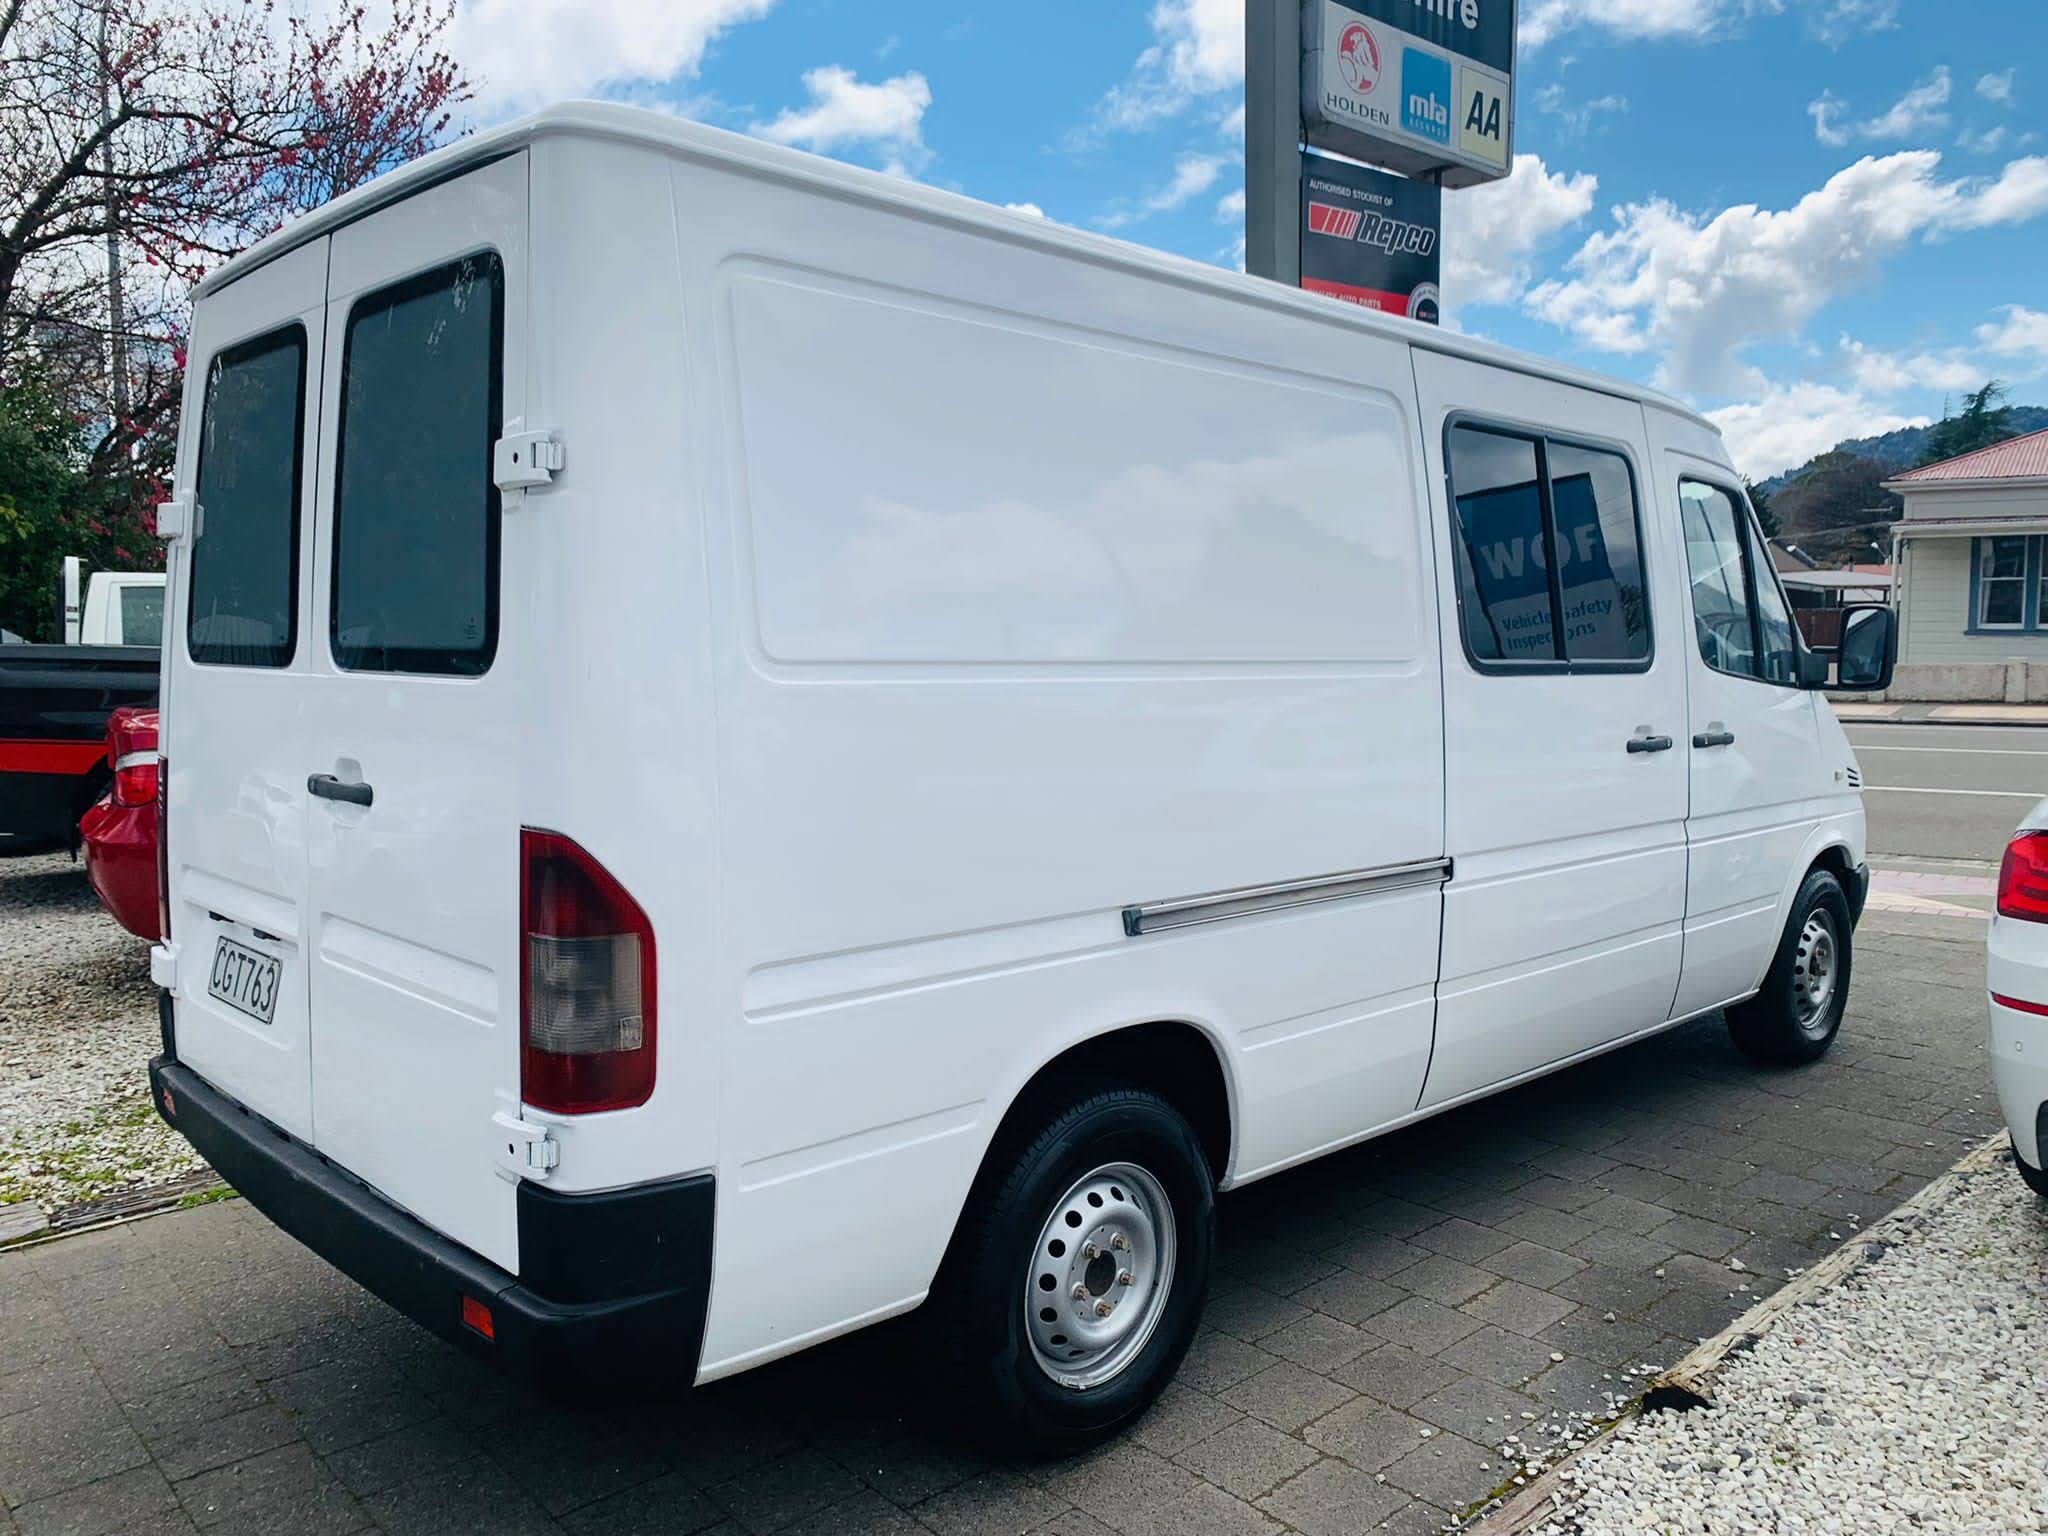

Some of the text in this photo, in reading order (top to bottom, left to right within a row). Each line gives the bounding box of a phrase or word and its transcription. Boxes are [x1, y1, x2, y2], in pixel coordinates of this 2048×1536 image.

[1415, 0, 1478, 29] re
[1326, 92, 1390, 125] HOLDEN
[1465, 90, 1500, 141] AA
[1309, 179, 1393, 207] AUTHORISED STOCKIST OF
[1357, 209, 1436, 256] Repco
[1359, 297, 1381, 310] PARTS
[1480, 523, 1602, 580] WOF
[213, 945, 275, 1013] CGT763
